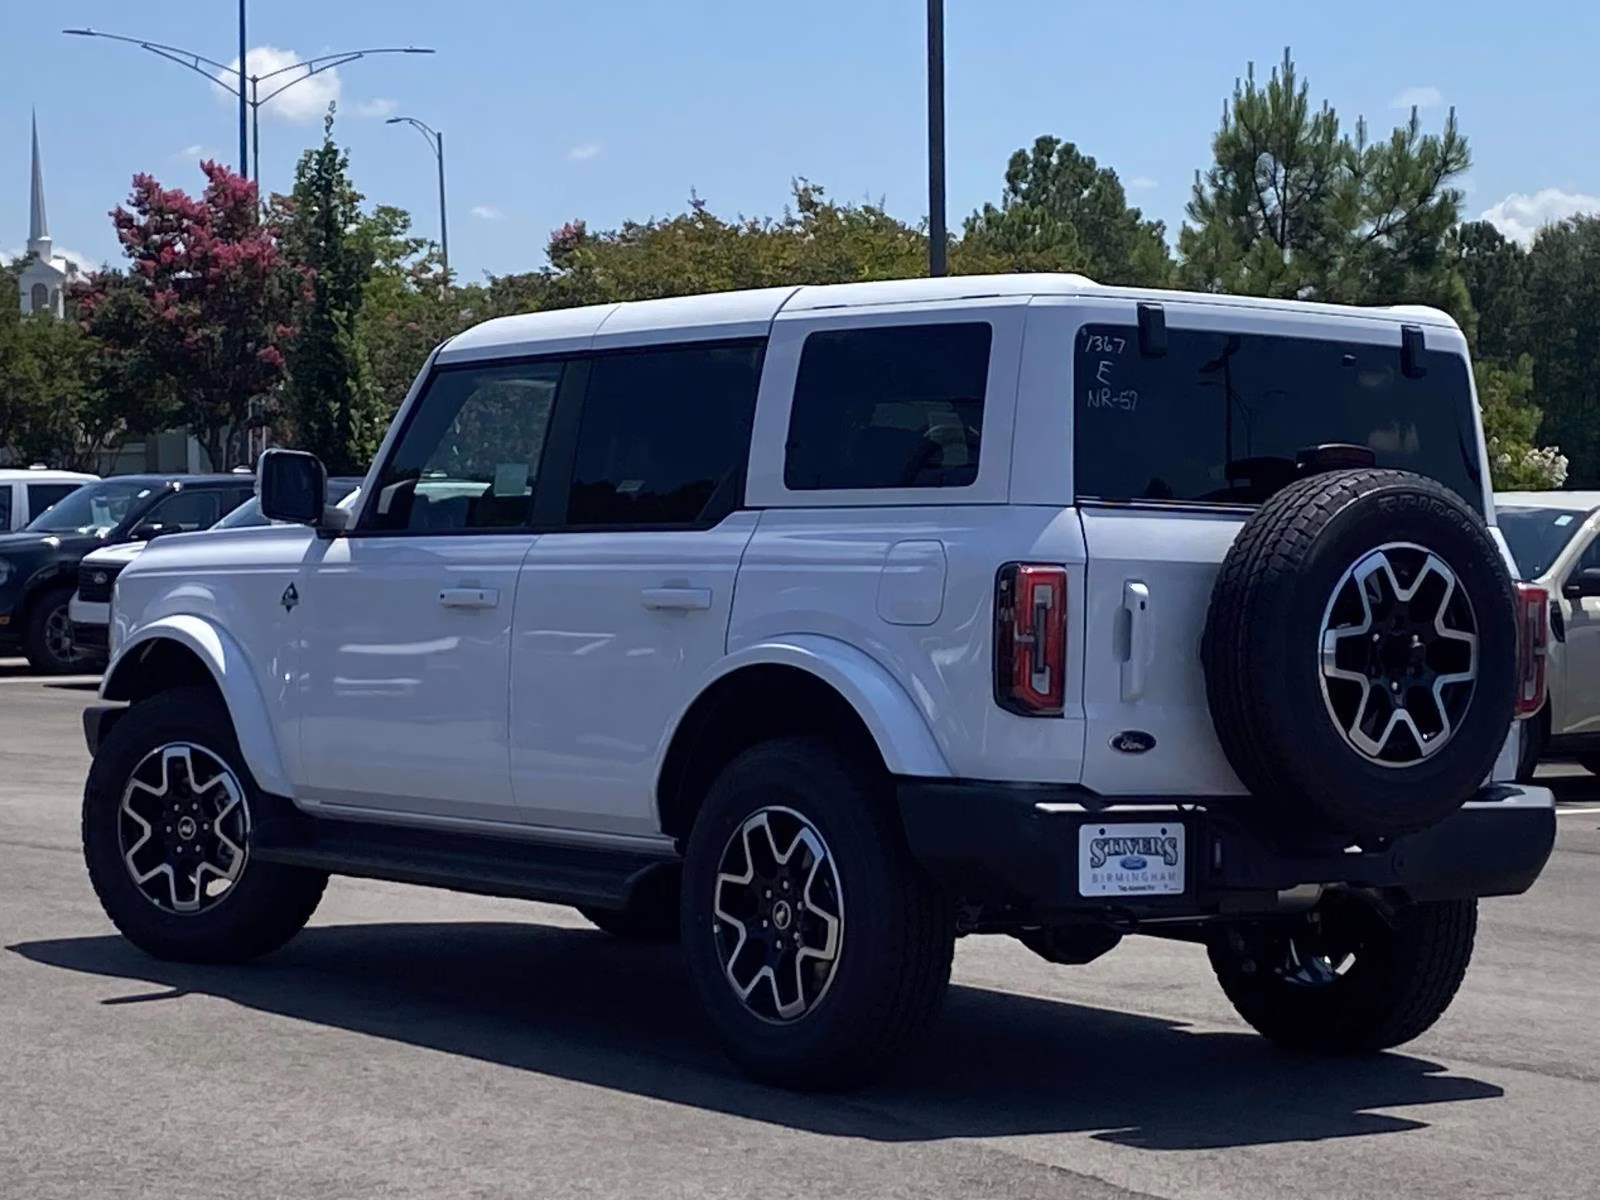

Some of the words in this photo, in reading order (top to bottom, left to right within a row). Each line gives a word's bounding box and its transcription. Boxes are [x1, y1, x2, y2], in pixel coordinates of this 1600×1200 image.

[1096, 360, 1114, 386] E
[1090, 837, 1178, 869] STIVERS
[1092, 872, 1176, 884] BIRMINGHAM
